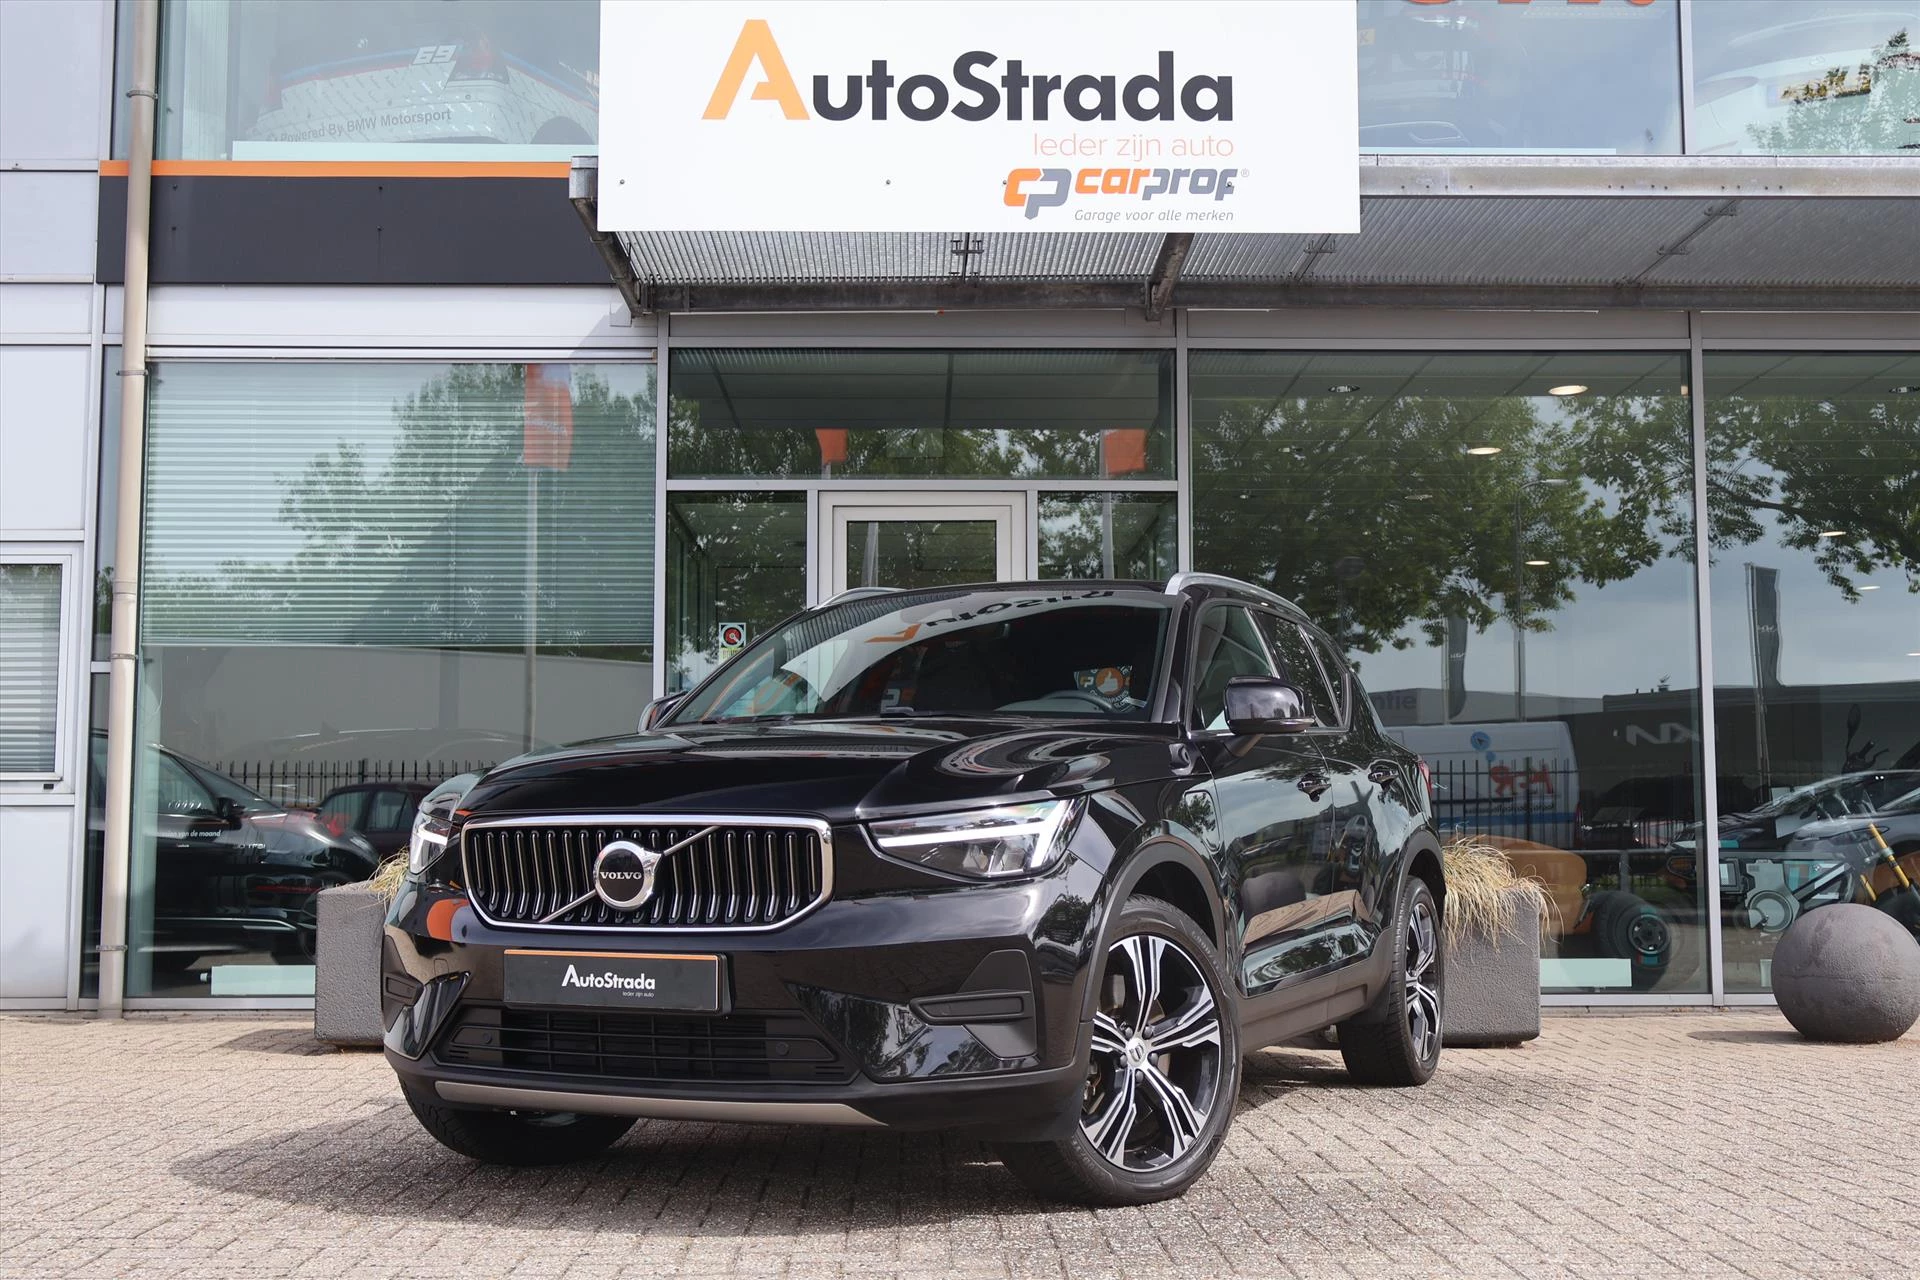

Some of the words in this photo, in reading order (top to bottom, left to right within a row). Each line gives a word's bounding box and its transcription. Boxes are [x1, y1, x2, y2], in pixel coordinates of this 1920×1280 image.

[702, 19, 1233, 122] AutoStrada
[281, 126, 325, 142] Powered
[329, 123, 344, 137] By
[347, 118, 377, 133] BMW
[381, 109, 452, 127] Motorsport
[1116, 134, 1161, 162] zijn
[1172, 136, 1234, 157] auto
[1075, 210, 1120, 223] Garage
[1126, 211, 1155, 221] voor
[1158, 210, 1182, 221] alle
[1186, 210, 1234, 221] merken
[600, 871, 642, 880] VOLVO
[562, 964, 656, 990] AutoStrada
